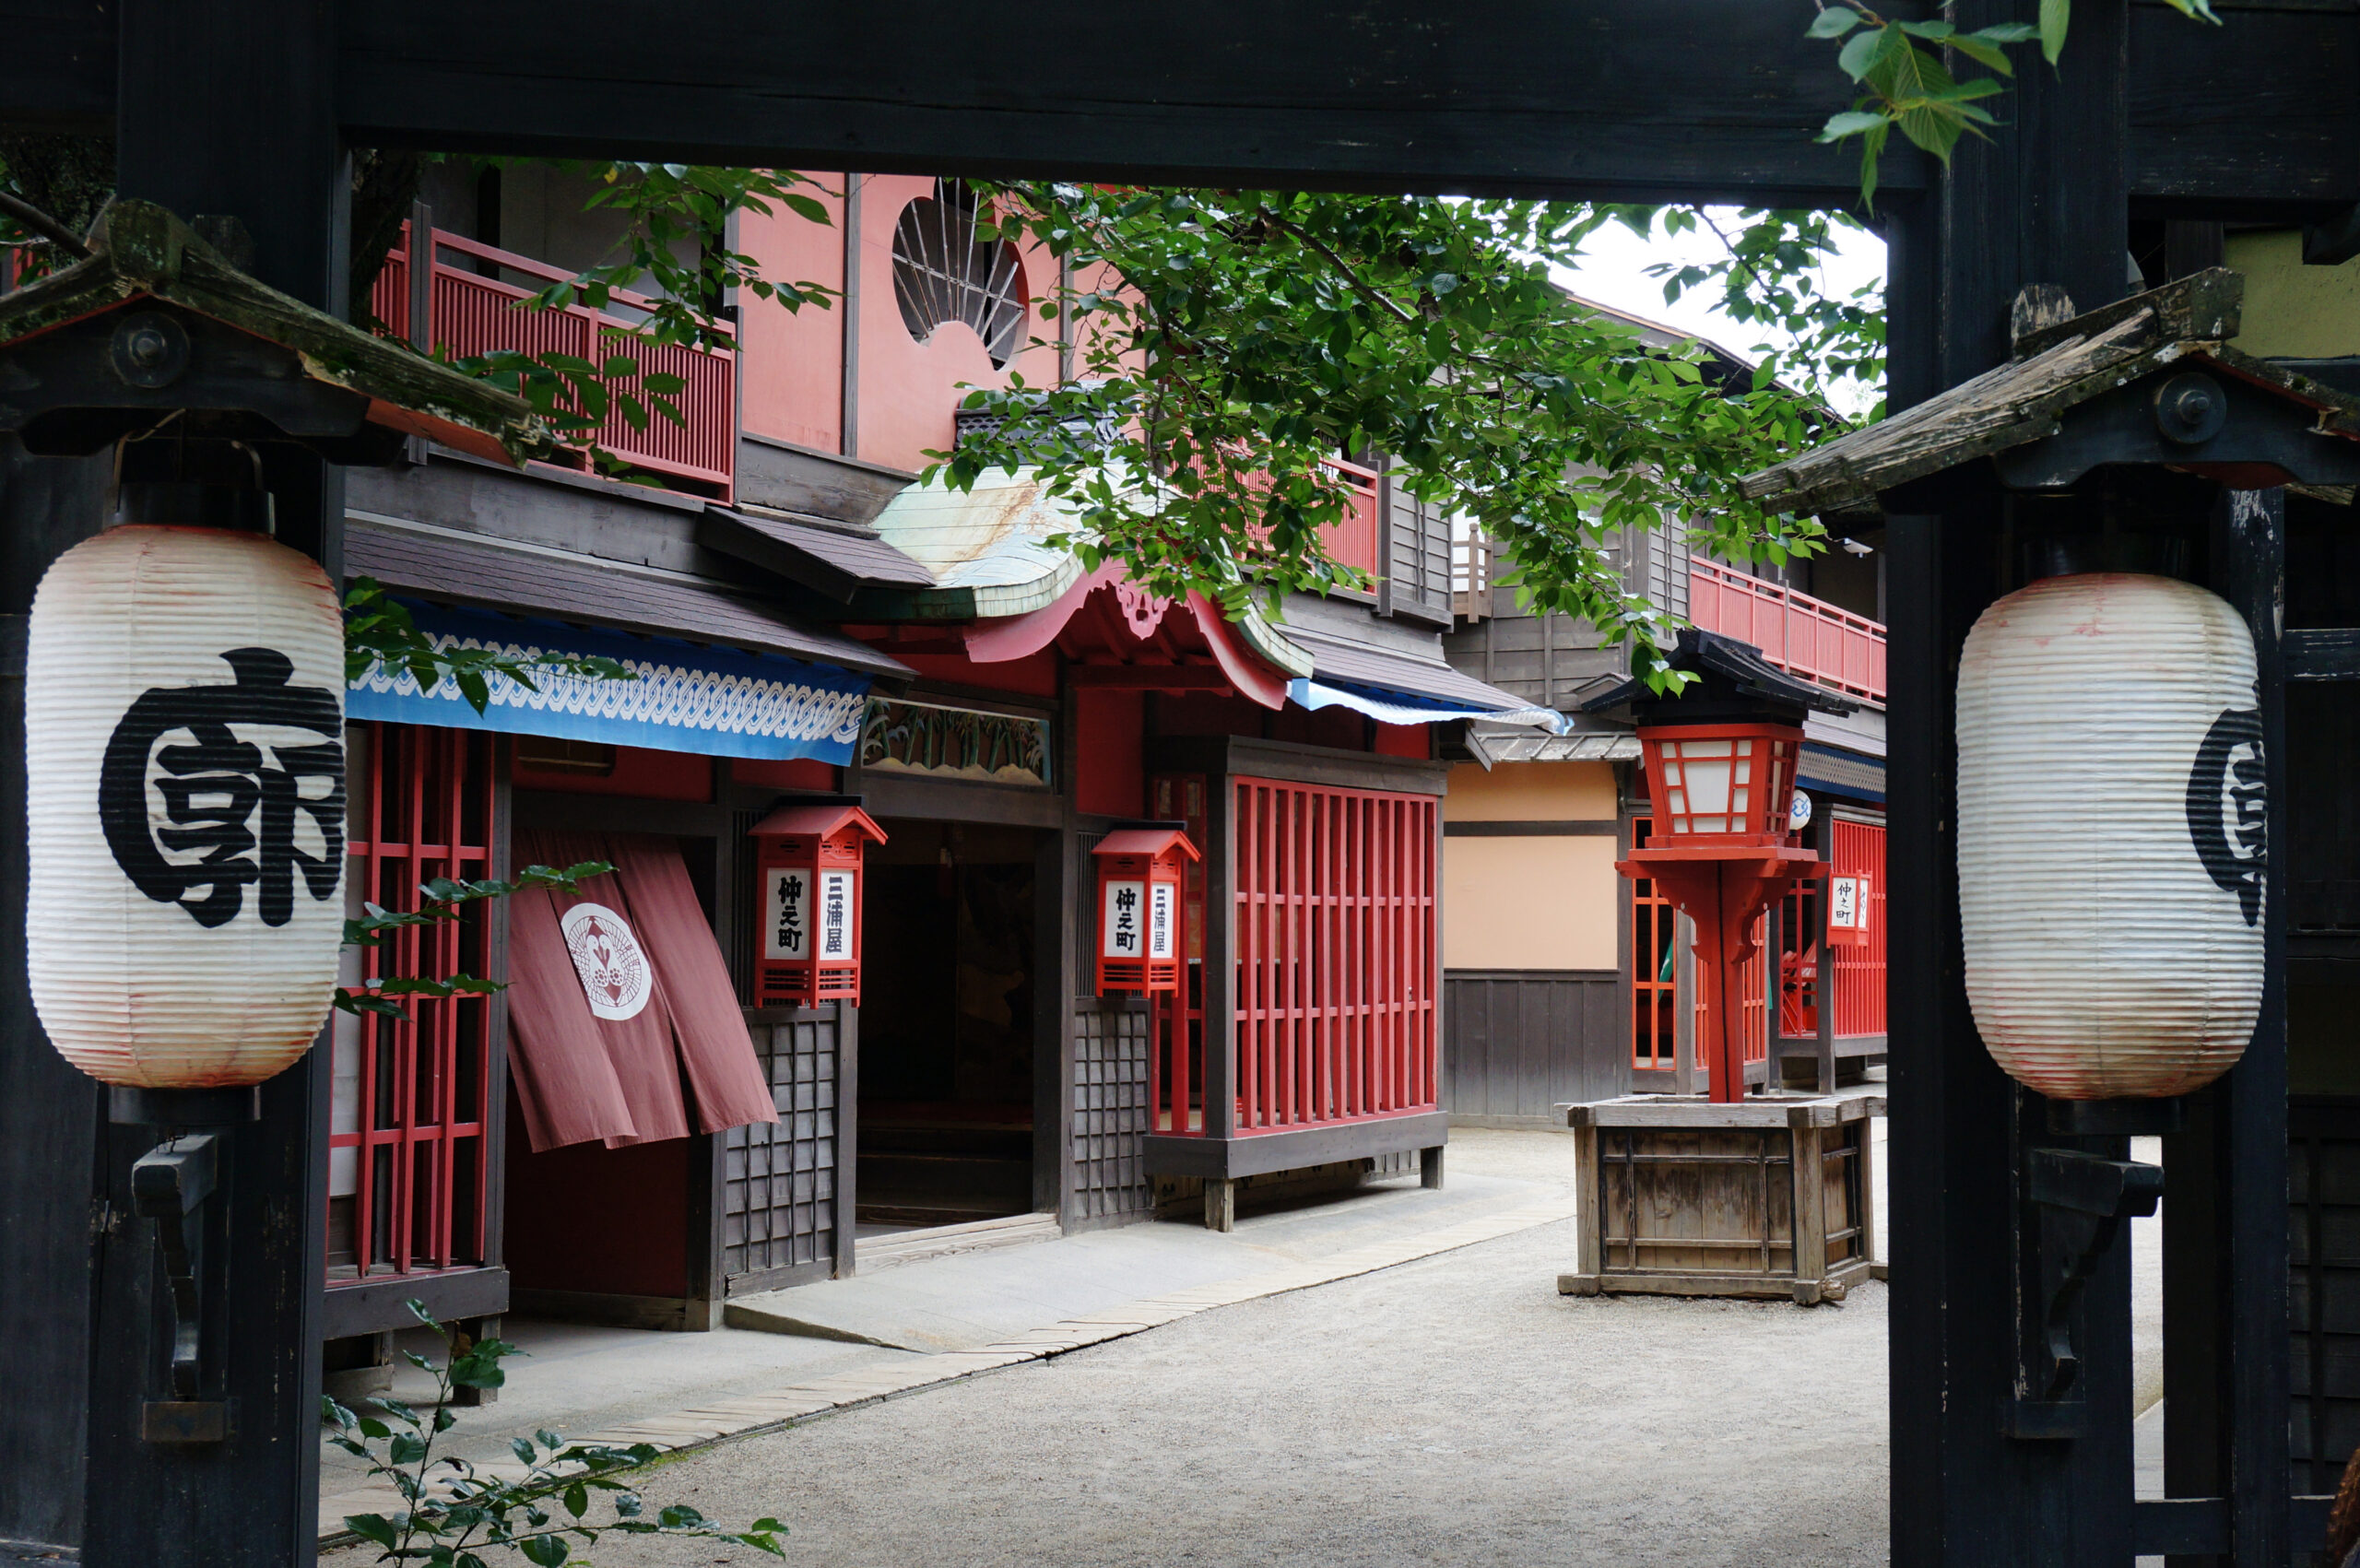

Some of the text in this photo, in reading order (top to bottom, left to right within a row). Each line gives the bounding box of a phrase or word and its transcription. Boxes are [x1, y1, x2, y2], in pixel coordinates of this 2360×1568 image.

[778, 875, 803, 952] 仲之町
[825, 877, 844, 953] 三浦屋
[1116, 888, 1136, 950] 仲之町
[1153, 889, 1167, 952] 三浦屋
[1835, 881, 1852, 925] 仲之町
